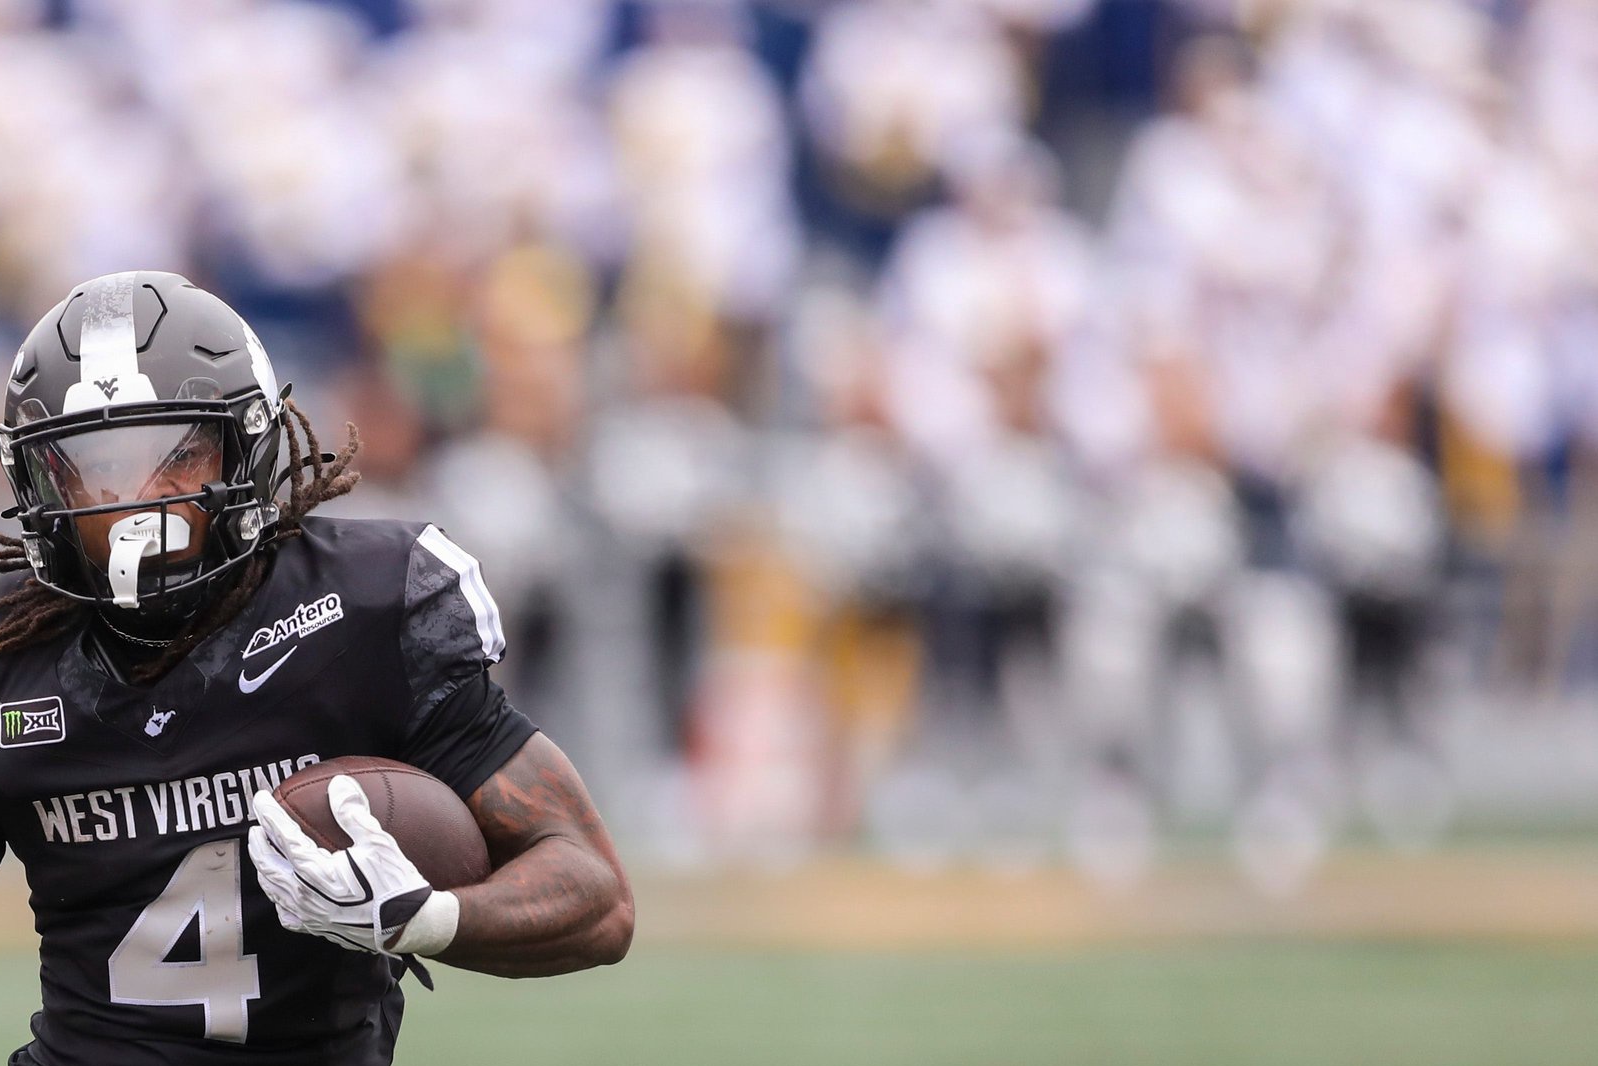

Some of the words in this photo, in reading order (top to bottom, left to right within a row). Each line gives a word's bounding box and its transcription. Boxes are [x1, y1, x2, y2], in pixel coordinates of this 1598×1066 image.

[273, 596, 338, 643] Antero
[300, 611, 341, 635] Resources
[33, 786, 137, 843] WEST
[143, 753, 321, 835] VIRGIN
[108, 838, 261, 1045] 4
